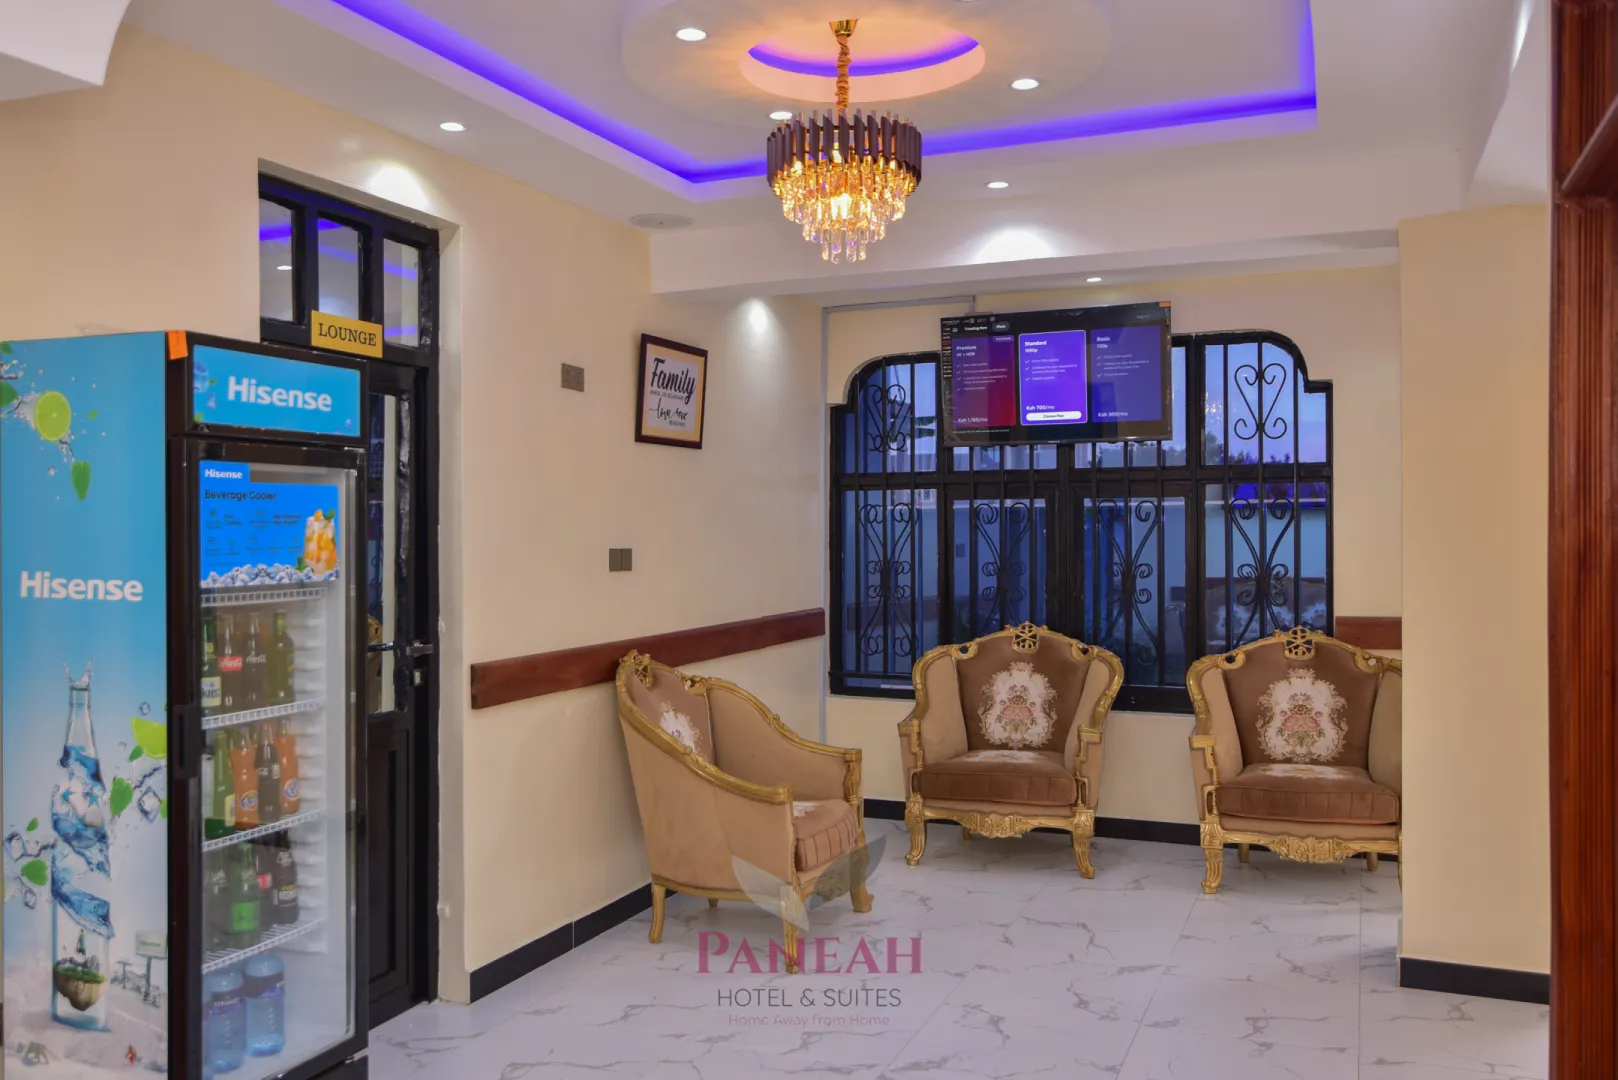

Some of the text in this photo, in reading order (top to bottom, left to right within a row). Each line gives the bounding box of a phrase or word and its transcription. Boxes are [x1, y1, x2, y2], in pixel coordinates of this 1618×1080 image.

[318, 322, 377, 347] LOUNGE
[228, 375, 332, 412] Hisense
[650, 357, 696, 405] Family
[205, 469, 243, 479] Hisense
[205, 489, 277, 501] Beverage Cooler
[20, 570, 144, 602] Hisense
